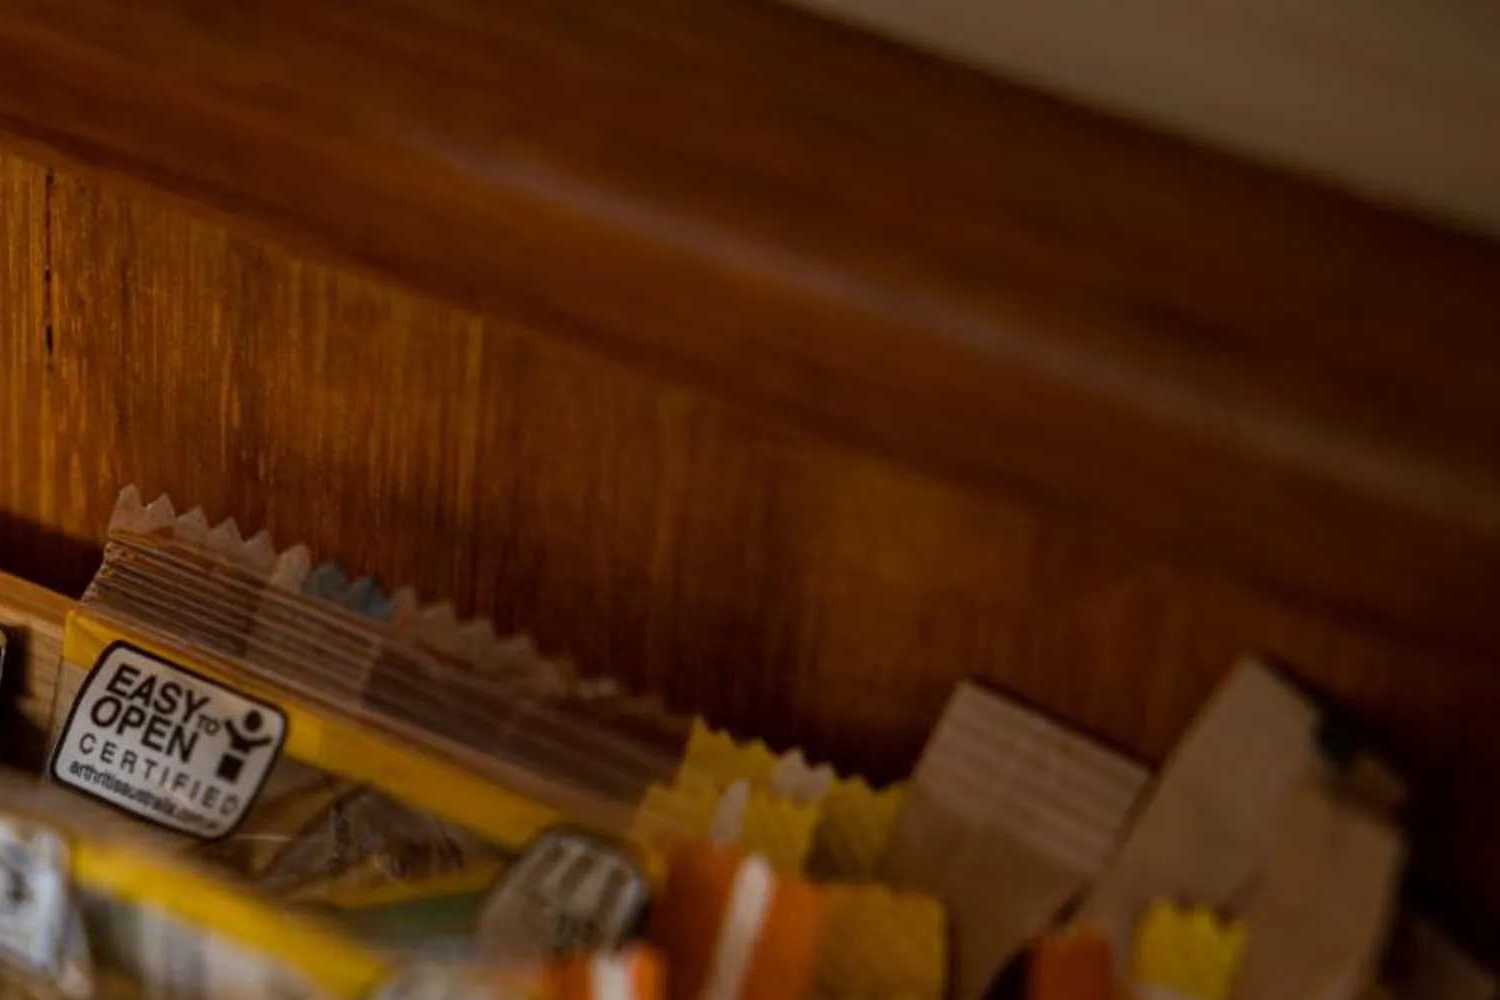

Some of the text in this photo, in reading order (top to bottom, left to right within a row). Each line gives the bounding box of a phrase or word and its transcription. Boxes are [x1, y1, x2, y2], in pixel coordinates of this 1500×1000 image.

[105, 664, 211, 722] EASY
[90, 696, 199, 764] OPEN
[79, 732, 241, 816] CERTIFIED
